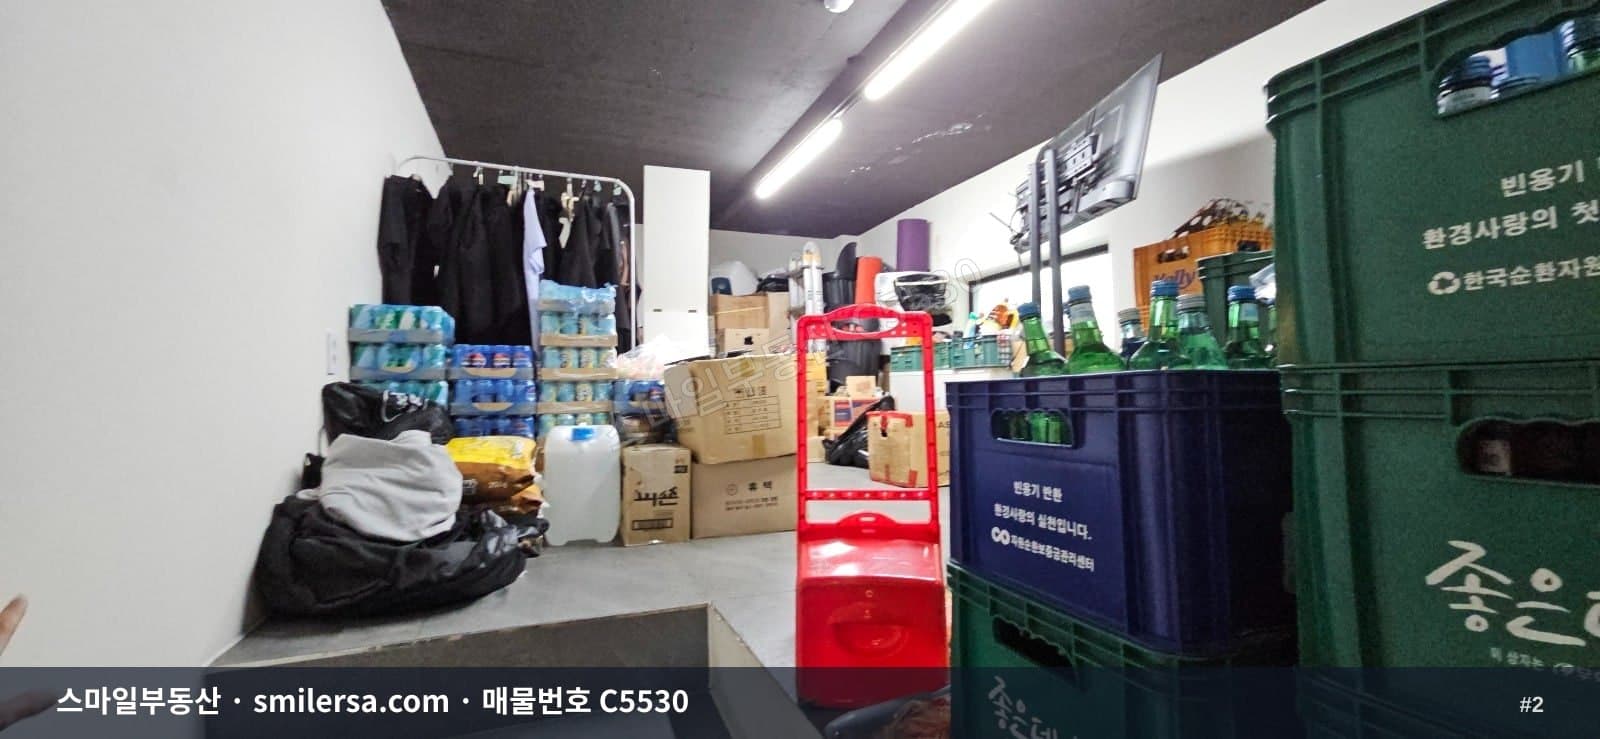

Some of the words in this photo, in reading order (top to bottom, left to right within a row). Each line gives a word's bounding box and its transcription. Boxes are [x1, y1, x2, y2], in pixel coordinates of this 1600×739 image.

[1501, 159, 1585, 198] 빈용기
[1422, 205, 1558, 250] 환경사랑의
[1464, 254, 1600, 291] 한국순환자원
[1013, 481, 1040, 499] 빈용기
[1042, 486, 1063, 503] 반환
[993, 503, 1036, 526] 환경사랑의
[1038, 514, 1093, 540] 실천입니다.
[1425, 540, 1600, 646] 좋은
